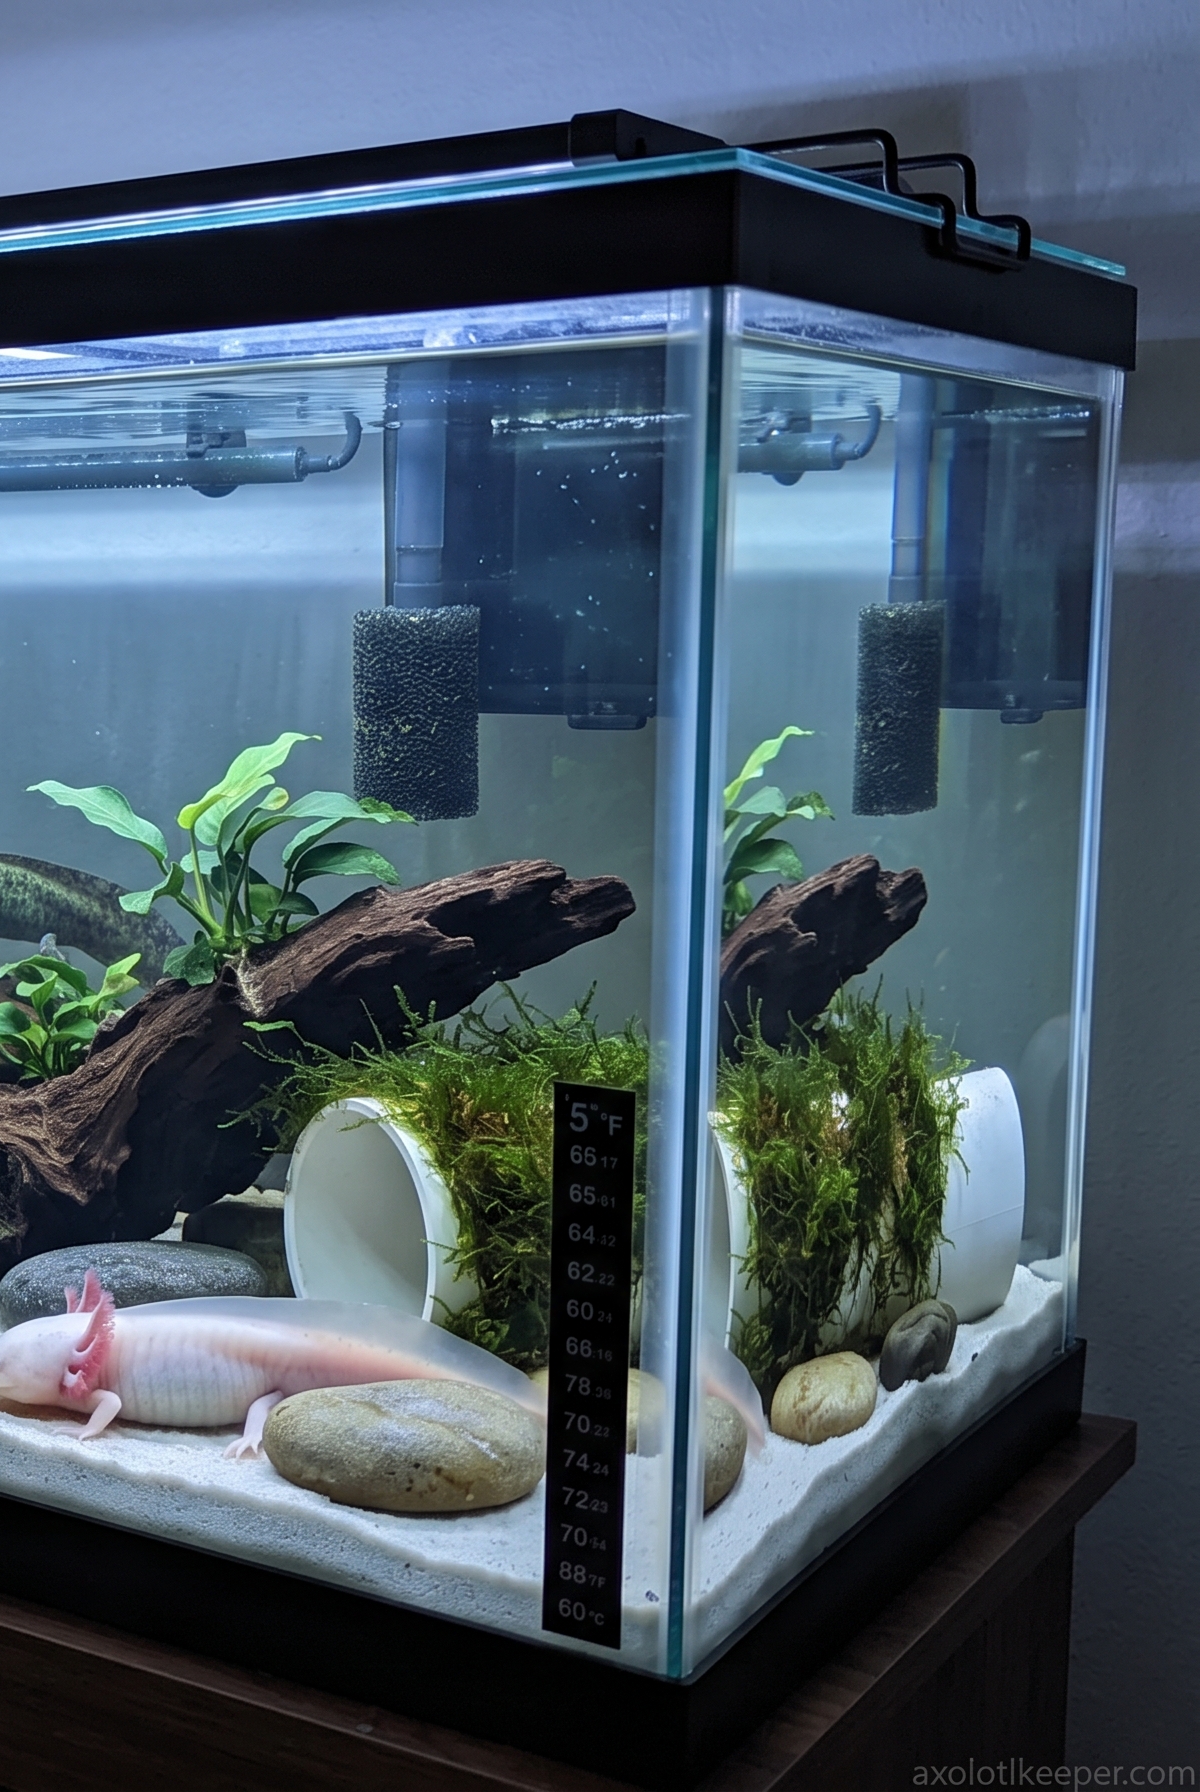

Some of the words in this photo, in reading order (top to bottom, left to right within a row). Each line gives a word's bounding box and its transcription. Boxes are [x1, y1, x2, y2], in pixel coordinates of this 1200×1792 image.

[570, 1145, 597, 1166] 66
[601, 1156, 618, 1169] 17
[569, 1183, 596, 1205] 65
[568, 1223, 595, 1244] 64
[567, 1261, 595, 1283] 62
[566, 1299, 594, 1320] 60
[566, 1336, 592, 1358] 66
[565, 1373, 591, 1396] 78
[564, 1411, 590, 1433] 70
[563, 1448, 590, 1471] 74
[562, 1486, 589, 1510] 72
[560, 1523, 588, 1547] 70
[559, 1561, 586, 1584] 88
[558, 1598, 586, 1621] 60
